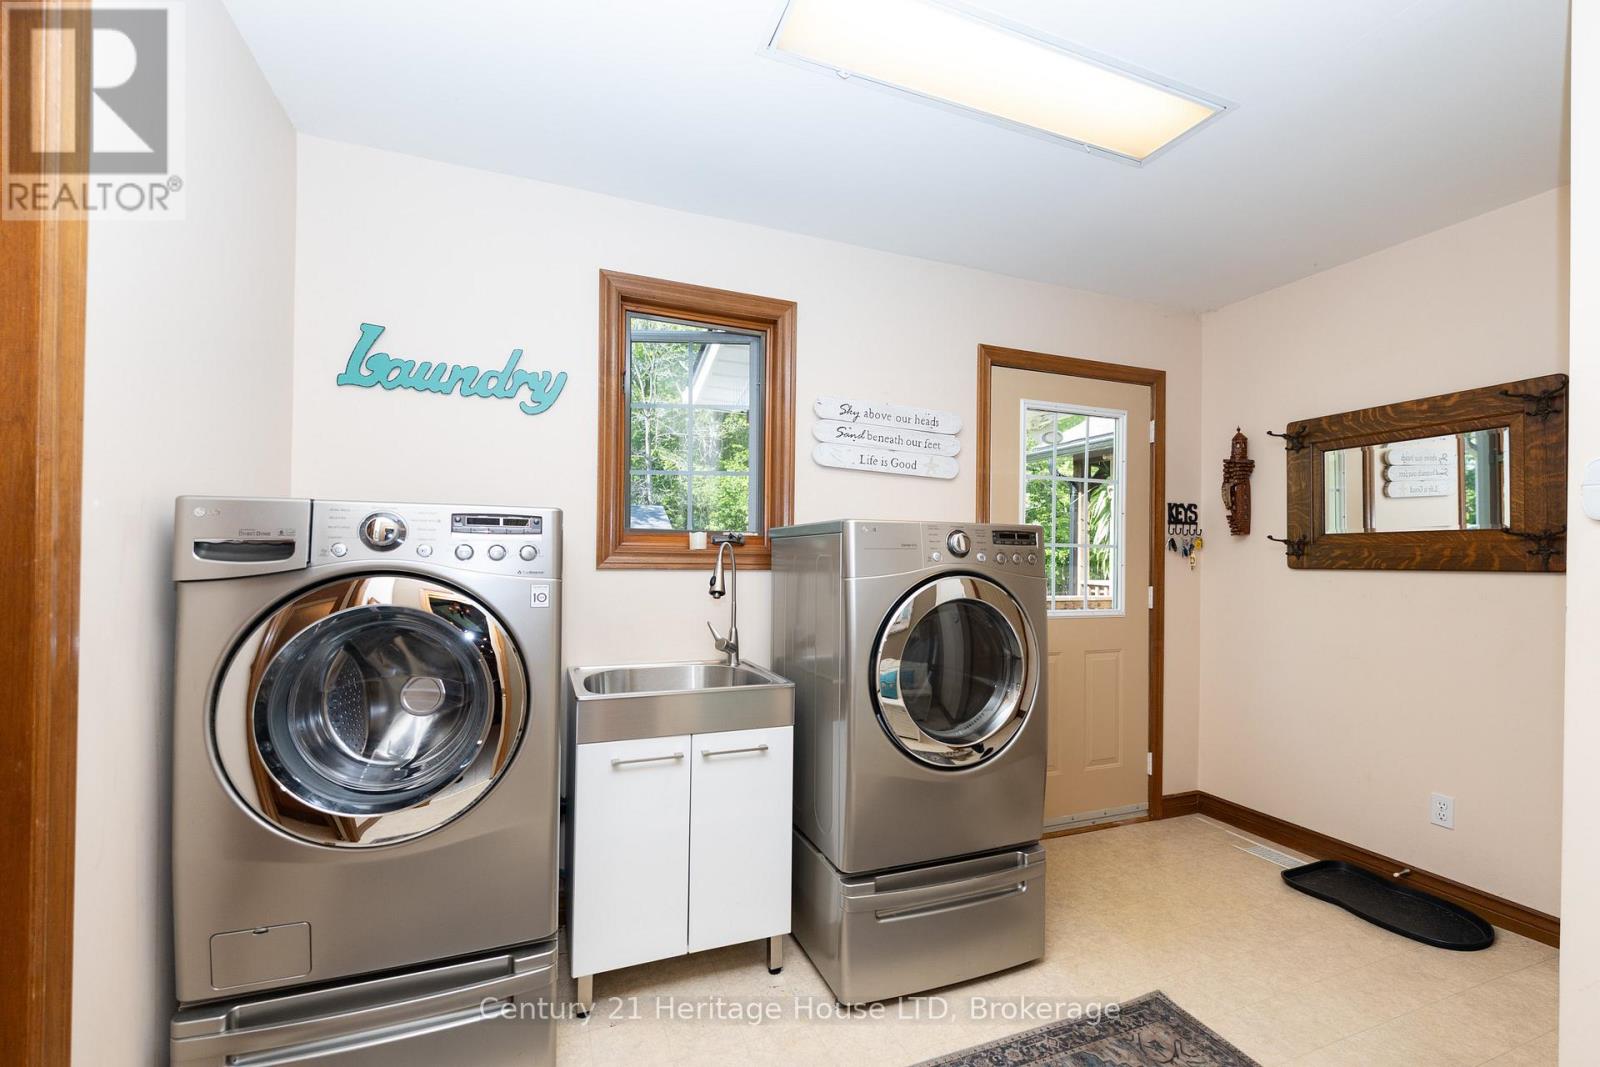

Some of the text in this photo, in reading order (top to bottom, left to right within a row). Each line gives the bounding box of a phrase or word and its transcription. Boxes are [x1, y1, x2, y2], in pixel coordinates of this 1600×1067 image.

[337, 323, 568, 415] Laundry
[839, 403, 939, 427] Sky above our heads
[835, 426, 941, 450] Sand beneath our feet
[859, 454, 917, 470] Life is Good
[1167, 503, 1198, 524] KEYS
